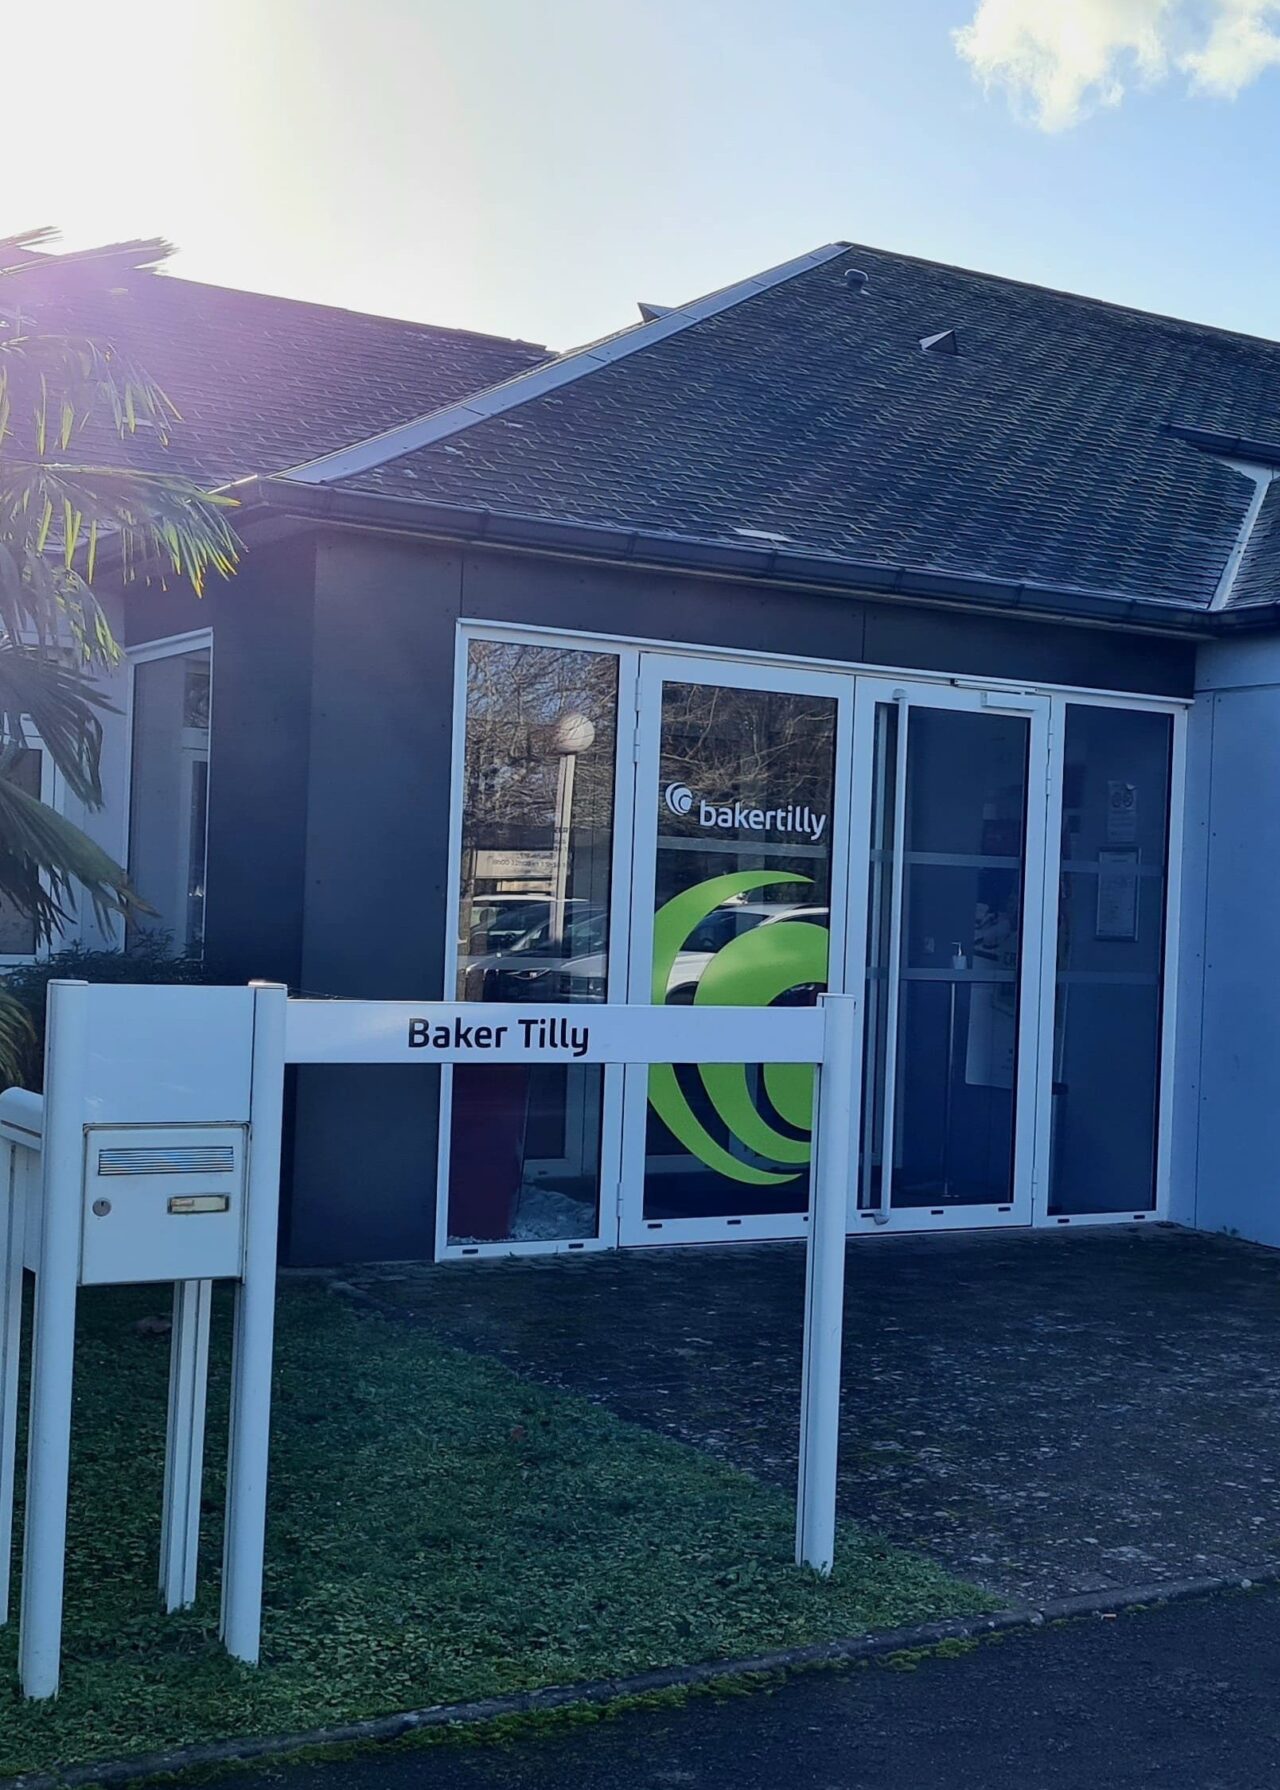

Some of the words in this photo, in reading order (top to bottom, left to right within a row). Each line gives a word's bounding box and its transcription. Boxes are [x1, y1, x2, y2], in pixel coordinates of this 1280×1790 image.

[700, 800, 826, 841] bakertilly
[408, 1017, 508, 1049] Baker
[518, 1018, 589, 1057] Tilly
